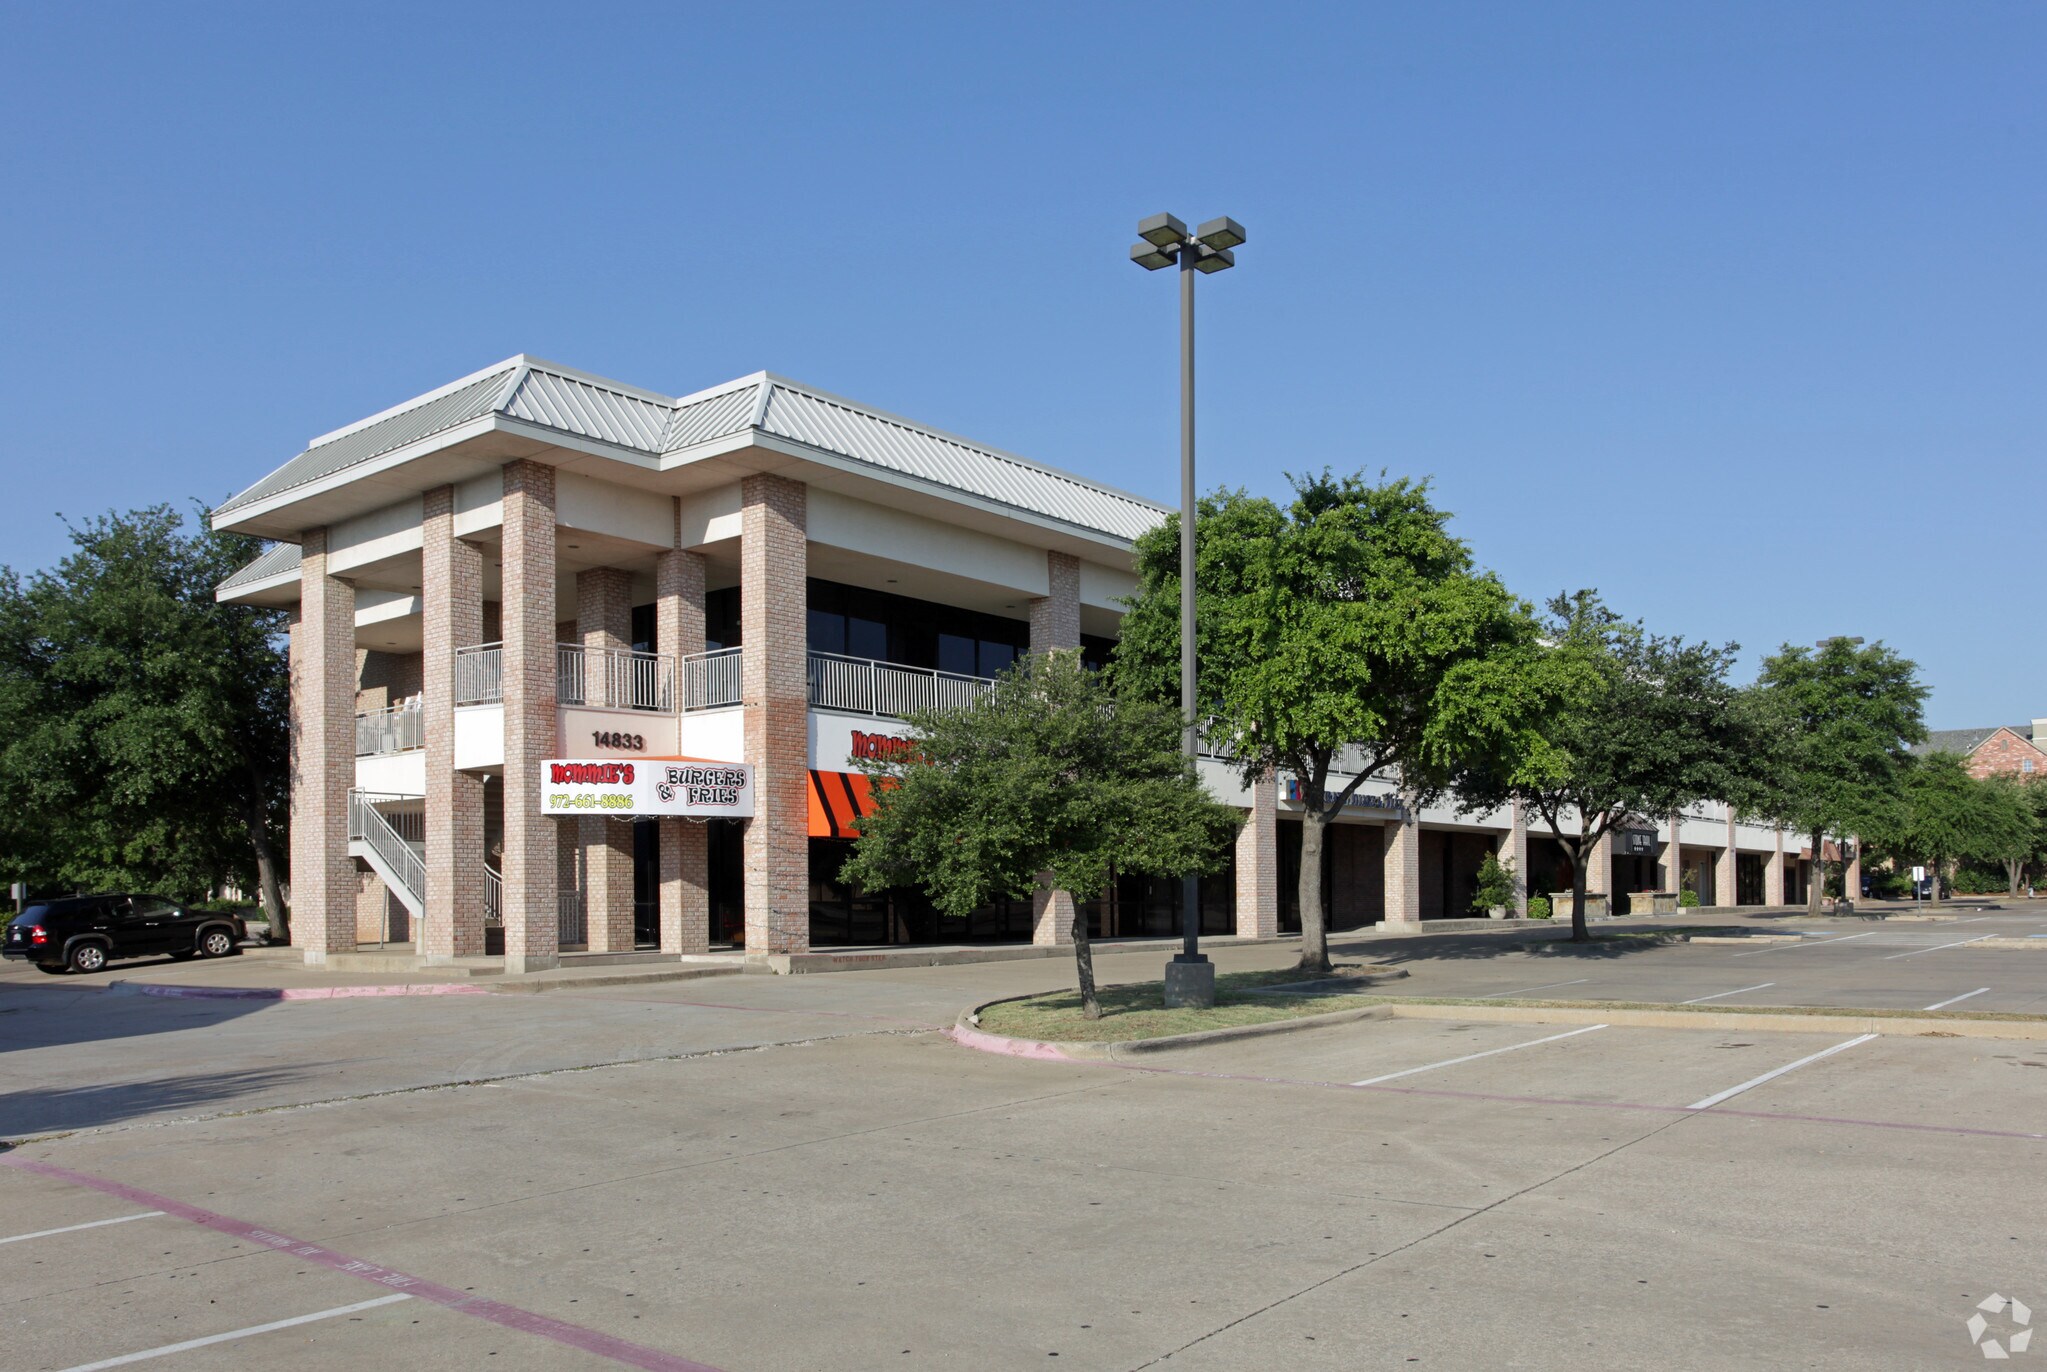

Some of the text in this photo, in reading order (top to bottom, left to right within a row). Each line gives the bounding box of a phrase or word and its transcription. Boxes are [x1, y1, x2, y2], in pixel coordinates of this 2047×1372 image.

[592, 730, 643, 750] 14833
[851, 730, 935, 767] MOMM
[550, 763, 635, 785] MOMMIE'S
[667, 767, 746, 788] BURGERS
[549, 794, 634, 809] 972-661-8886
[657, 783, 739, 805] & FRIES
